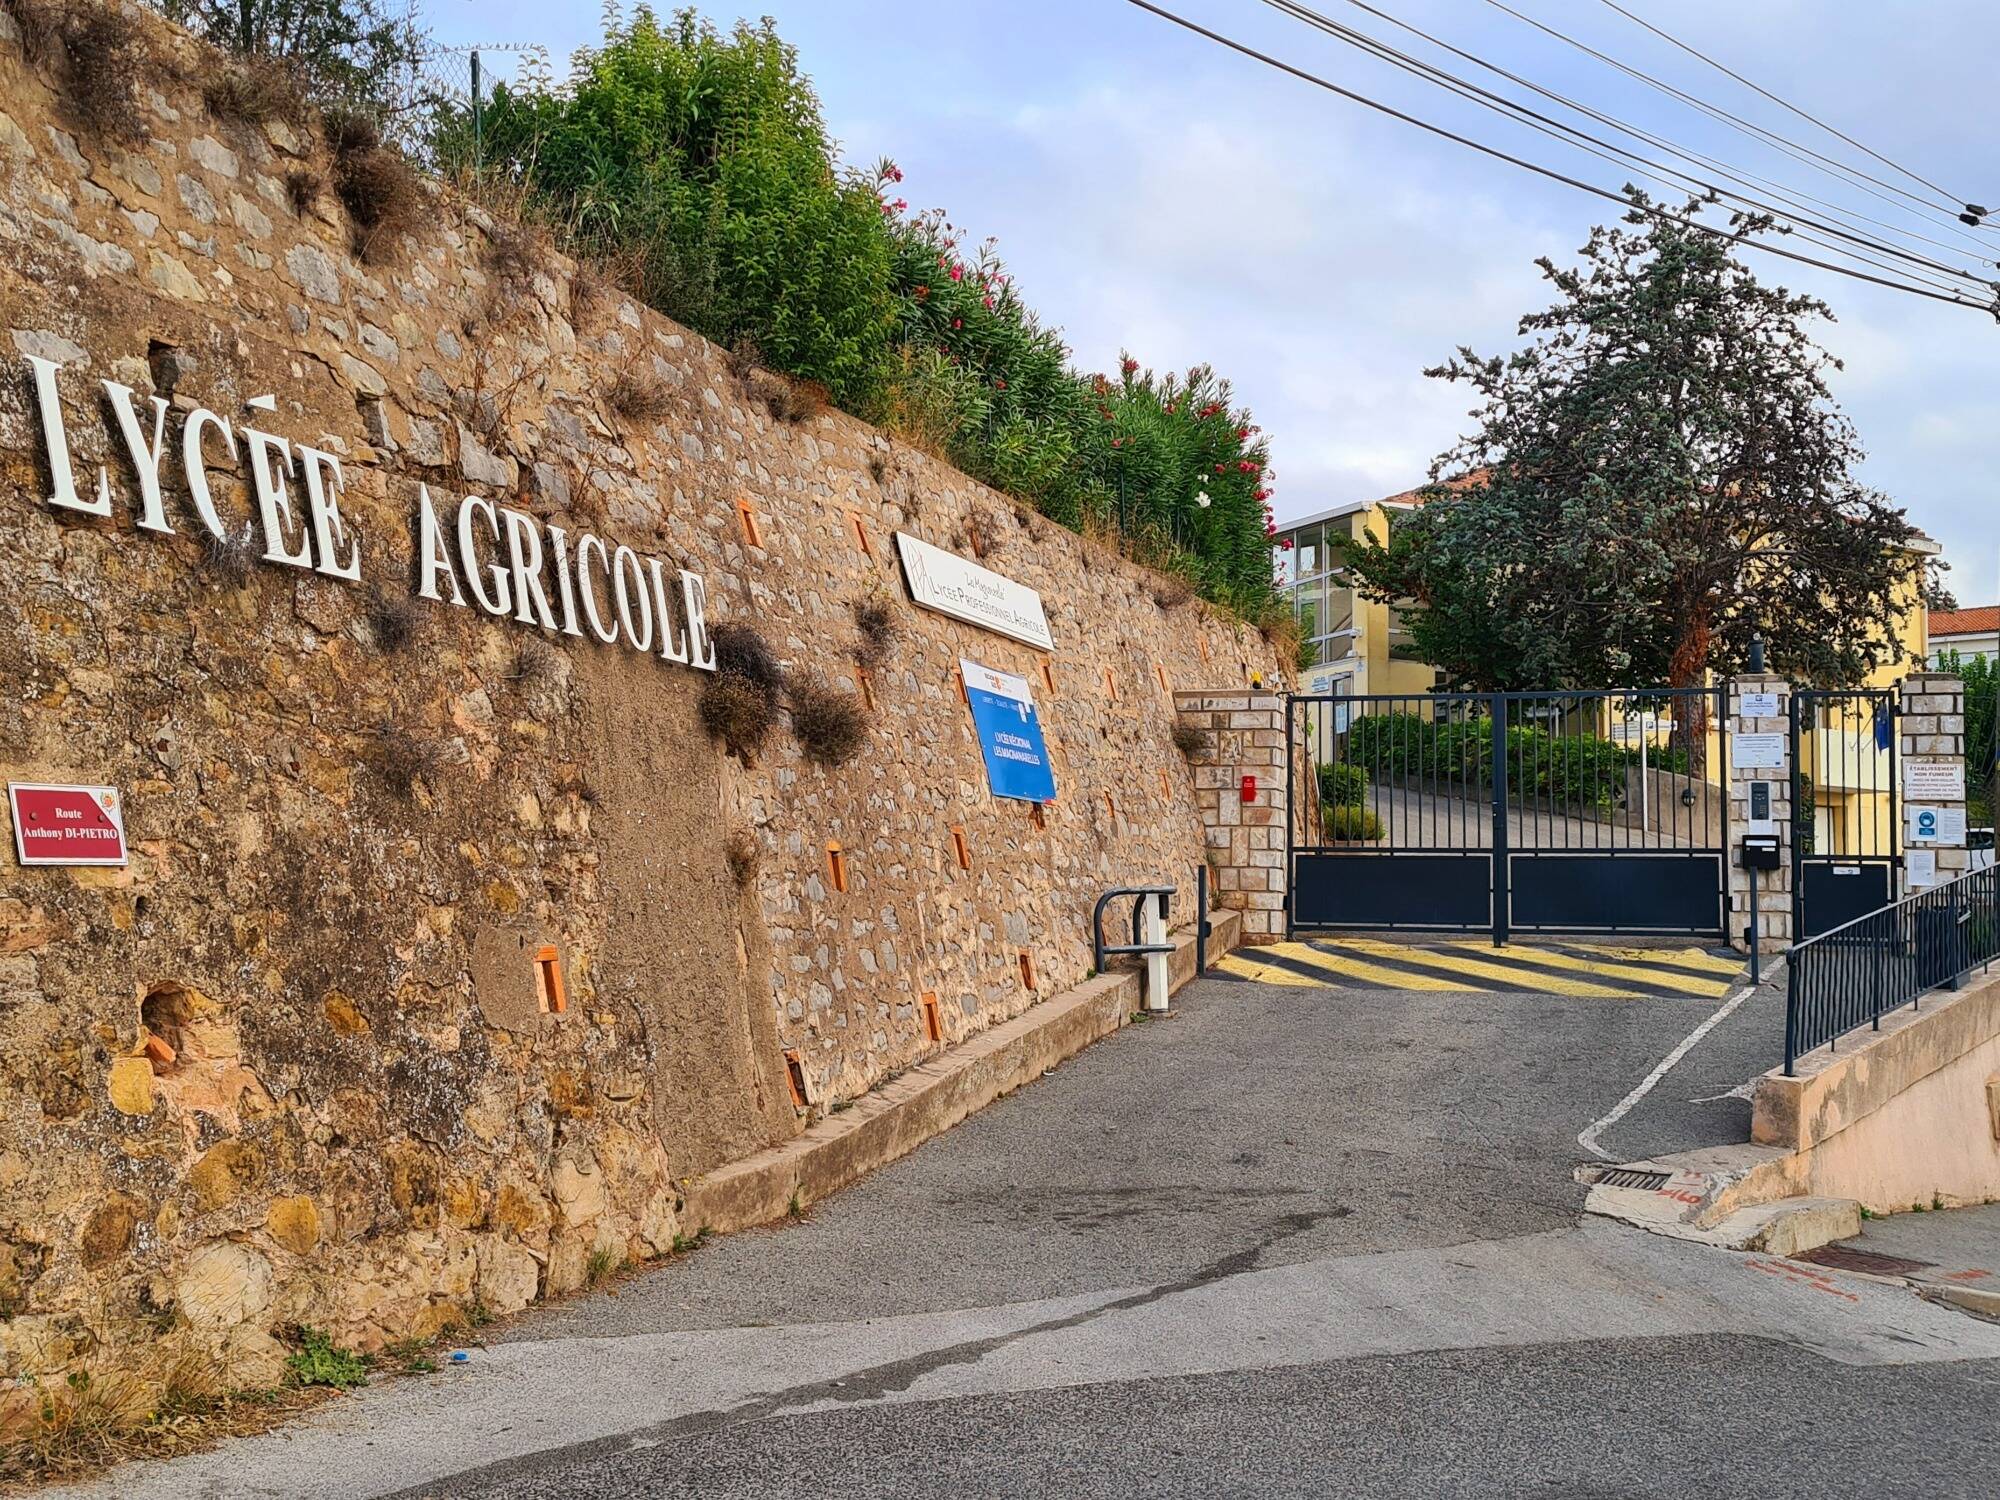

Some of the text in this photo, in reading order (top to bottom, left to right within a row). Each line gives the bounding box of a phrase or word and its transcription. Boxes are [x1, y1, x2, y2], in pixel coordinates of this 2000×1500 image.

[25, 354, 717, 672] LYCÉE AGRICOLE
[55, 807, 82, 819] Route
[24, 827, 118, 840] Anthony DI-PIETRO
